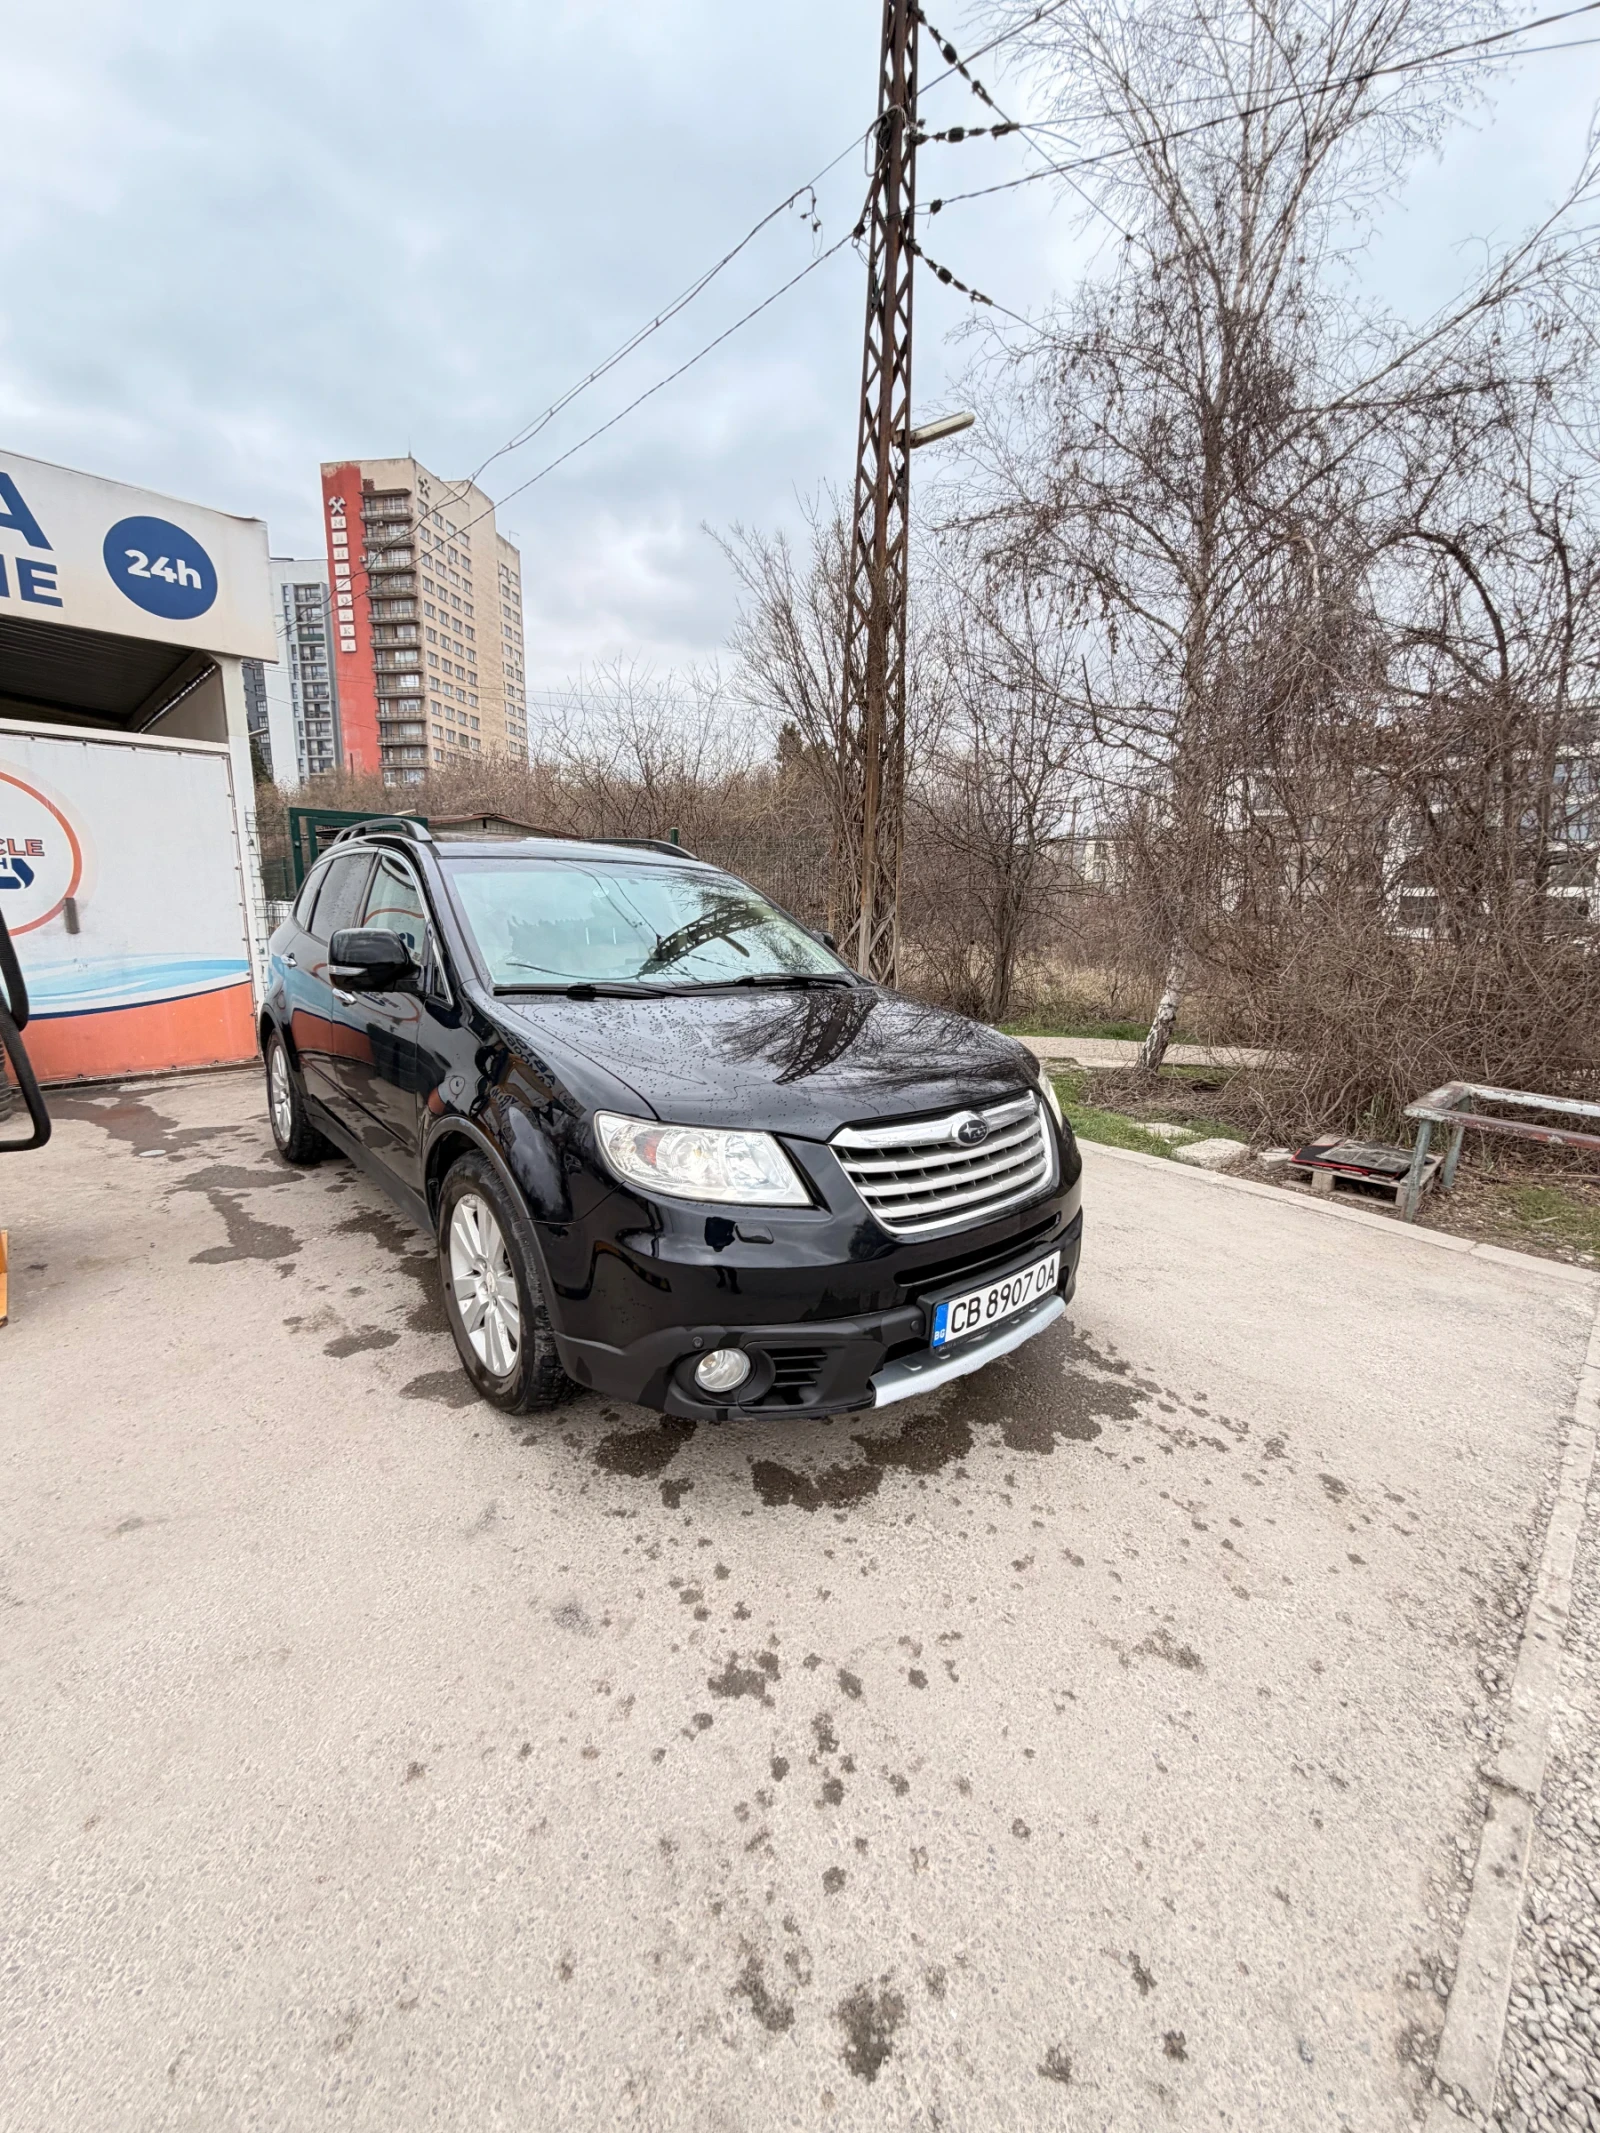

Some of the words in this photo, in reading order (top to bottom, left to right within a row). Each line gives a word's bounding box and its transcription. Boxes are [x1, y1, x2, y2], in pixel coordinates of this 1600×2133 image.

[124, 549, 202, 590] 24h
[951, 1297, 981, 1334] CB
[986, 1270, 1034, 1319] 8907
[1036, 1259, 1055, 1293] OA
[934, 1328, 946, 1341] BG
